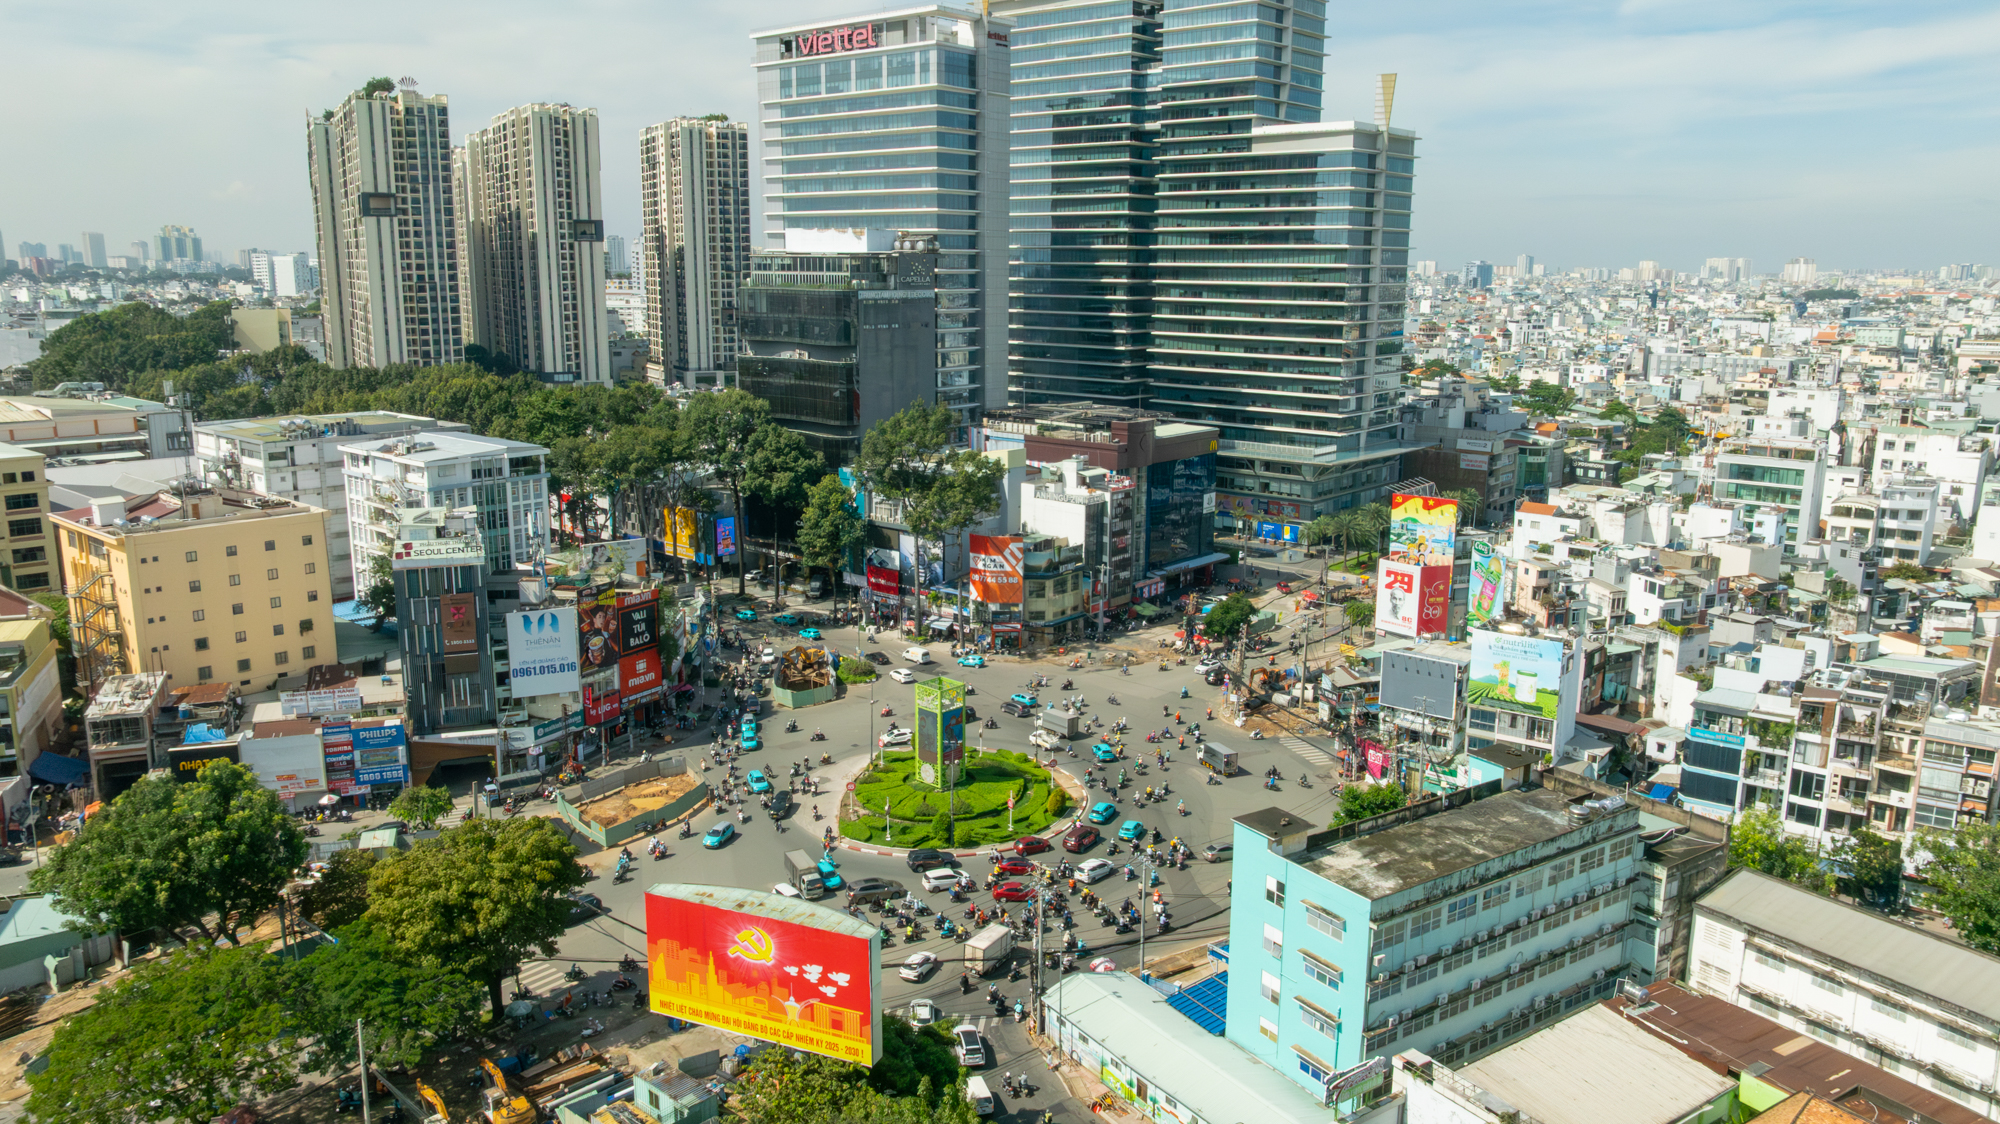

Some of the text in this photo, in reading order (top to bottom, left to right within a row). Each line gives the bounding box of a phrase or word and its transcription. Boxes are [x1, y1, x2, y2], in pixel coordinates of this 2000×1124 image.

[798, 23, 876, 54] viettel
[414, 546, 482, 556] SEOUL CENTER
[624, 592, 652, 606] mia.vn
[632, 610, 646, 620] VALI
[632, 621, 646, 633] TÚI
[630, 630, 650, 646] BALÔ
[1503, 640, 1538, 650] nutrilite
[512, 662, 576, 678] 0961.015.016
[628, 672, 655, 688] mia.vn
[360, 728, 397, 739] PHILIPS
[359, 773, 380, 782] 1800
[660, 999, 675, 1012] NHIỆT
[676, 1002, 687, 1015] LIỆT
[688, 1005, 703, 1018] CHÀO
[704, 1009, 720, 1022] MỪNG
[722, 1015, 731, 1027] ĐẠI
[733, 1017, 742, 1029] HỘI
[744, 1019, 759, 1032] ĐẢNG
[760, 1024, 768, 1036] BỘ
[770, 1026, 781, 1037] CÁC
[782, 1028, 794, 1040] CẤP
[796, 1033, 814, 1047] NHIỆM
[816, 1037, 823, 1048] KỲ
[825, 1041, 839, 1052] 2025
[845, 1046, 860, 1057] 2030
